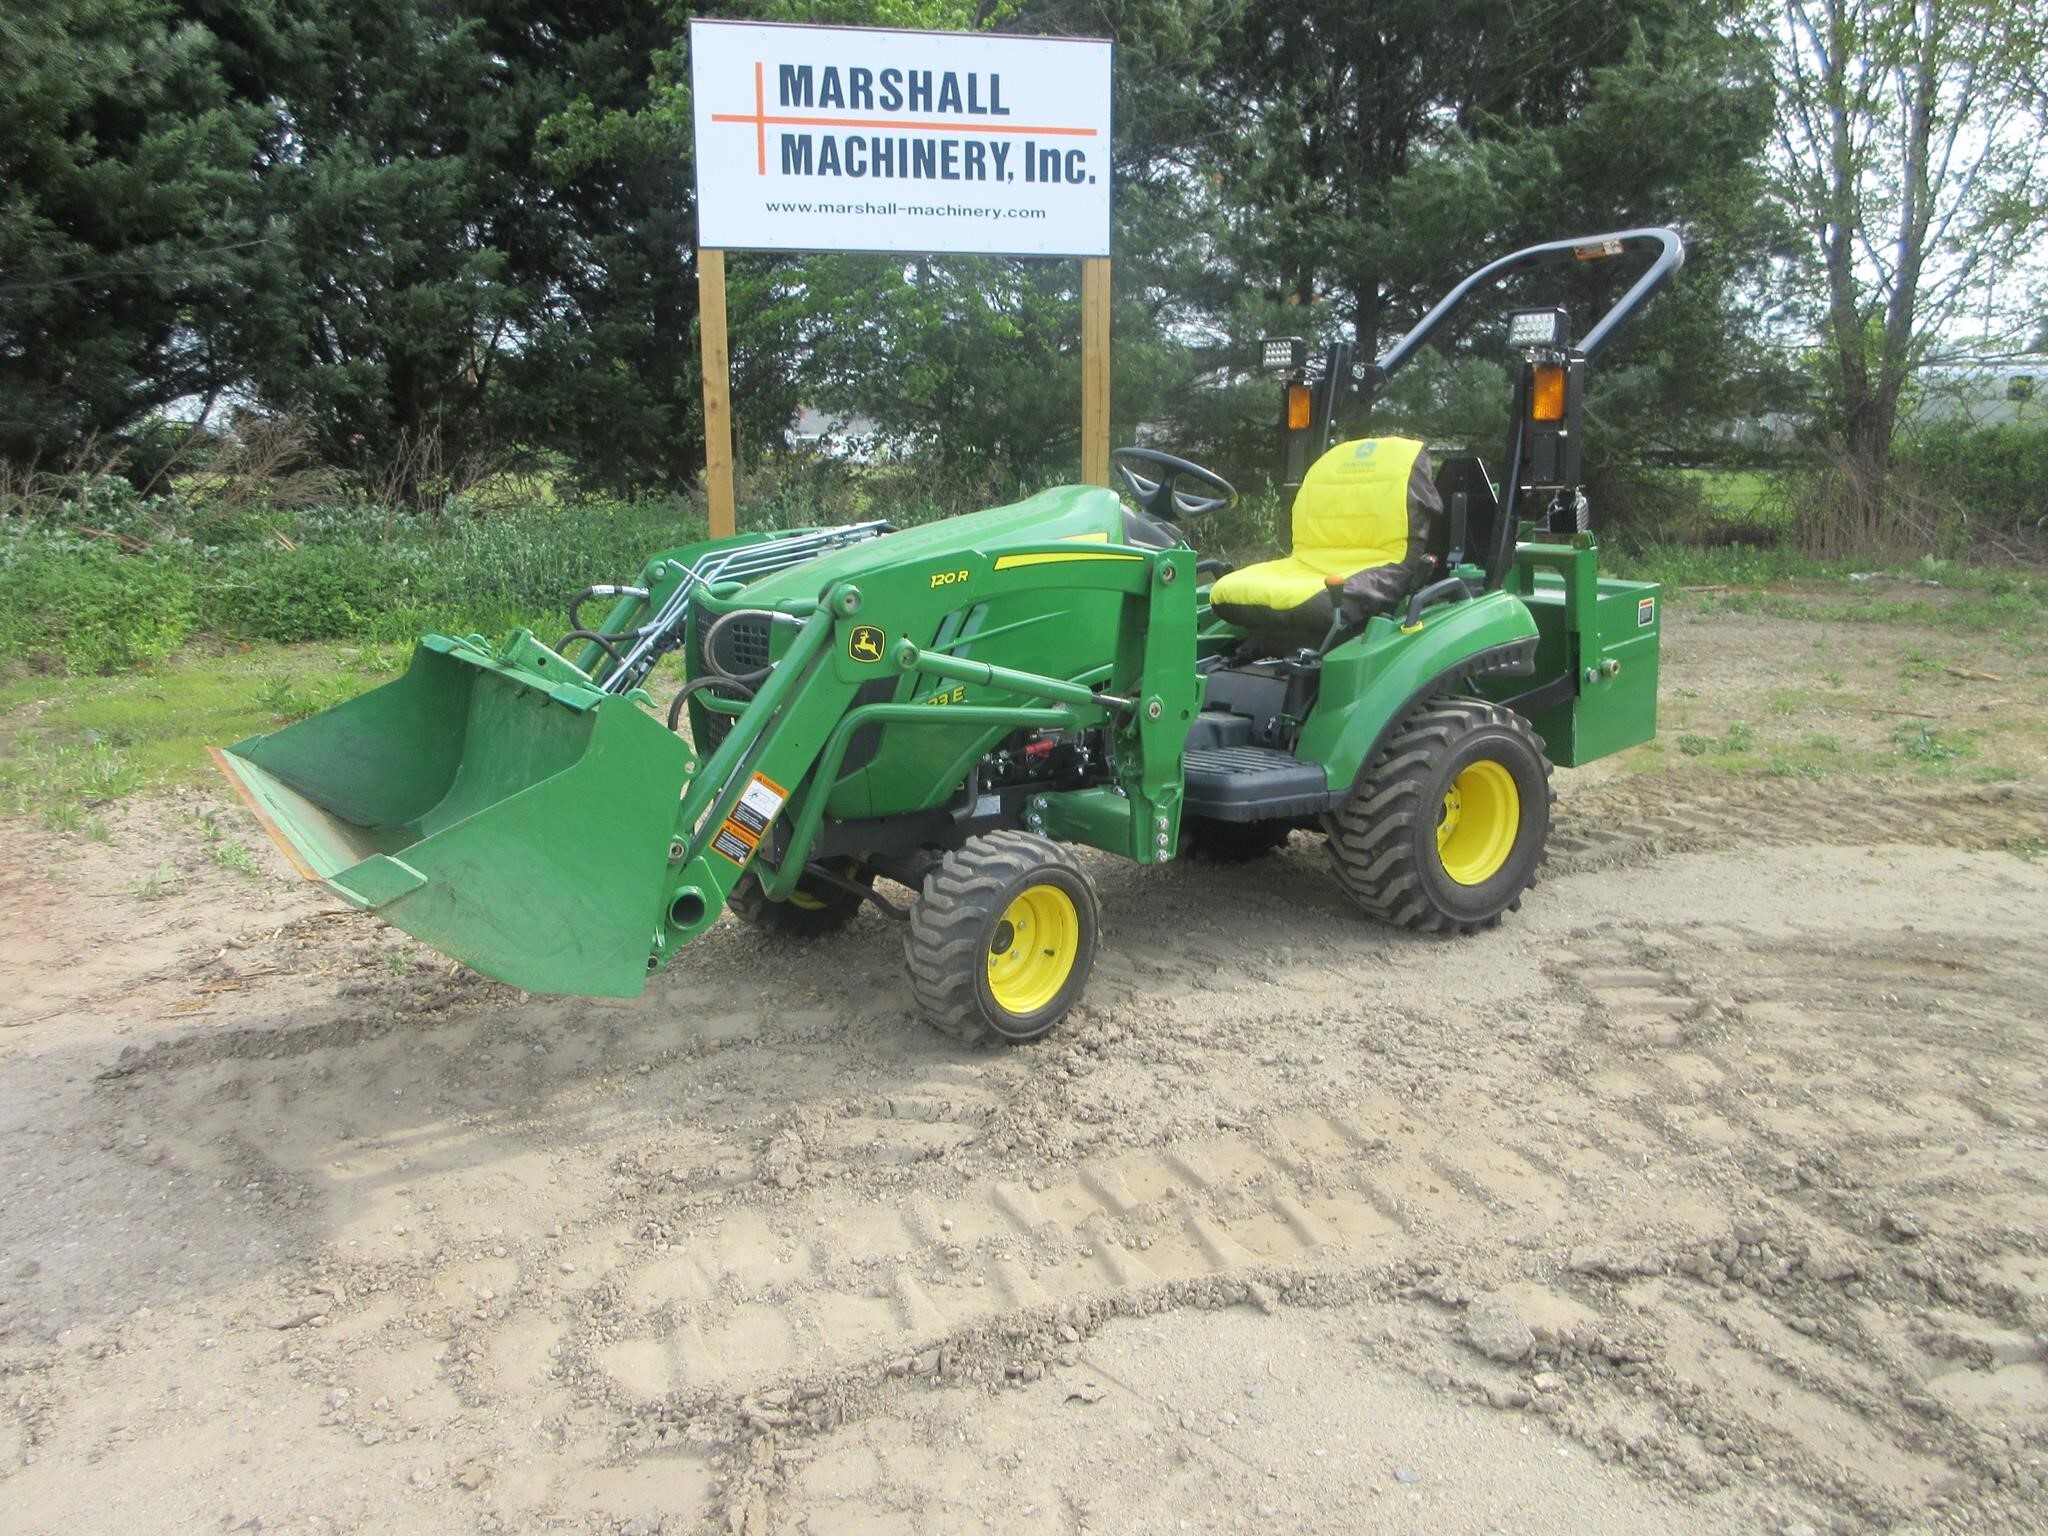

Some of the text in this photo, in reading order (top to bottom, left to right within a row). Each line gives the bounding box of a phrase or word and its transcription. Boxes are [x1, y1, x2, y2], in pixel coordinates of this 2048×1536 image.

[779, 63, 1010, 115] MARSHALL
[781, 133, 1096, 185] MACHINERY, Inc.
[766, 201, 1046, 220] www.marshall-machinery.com
